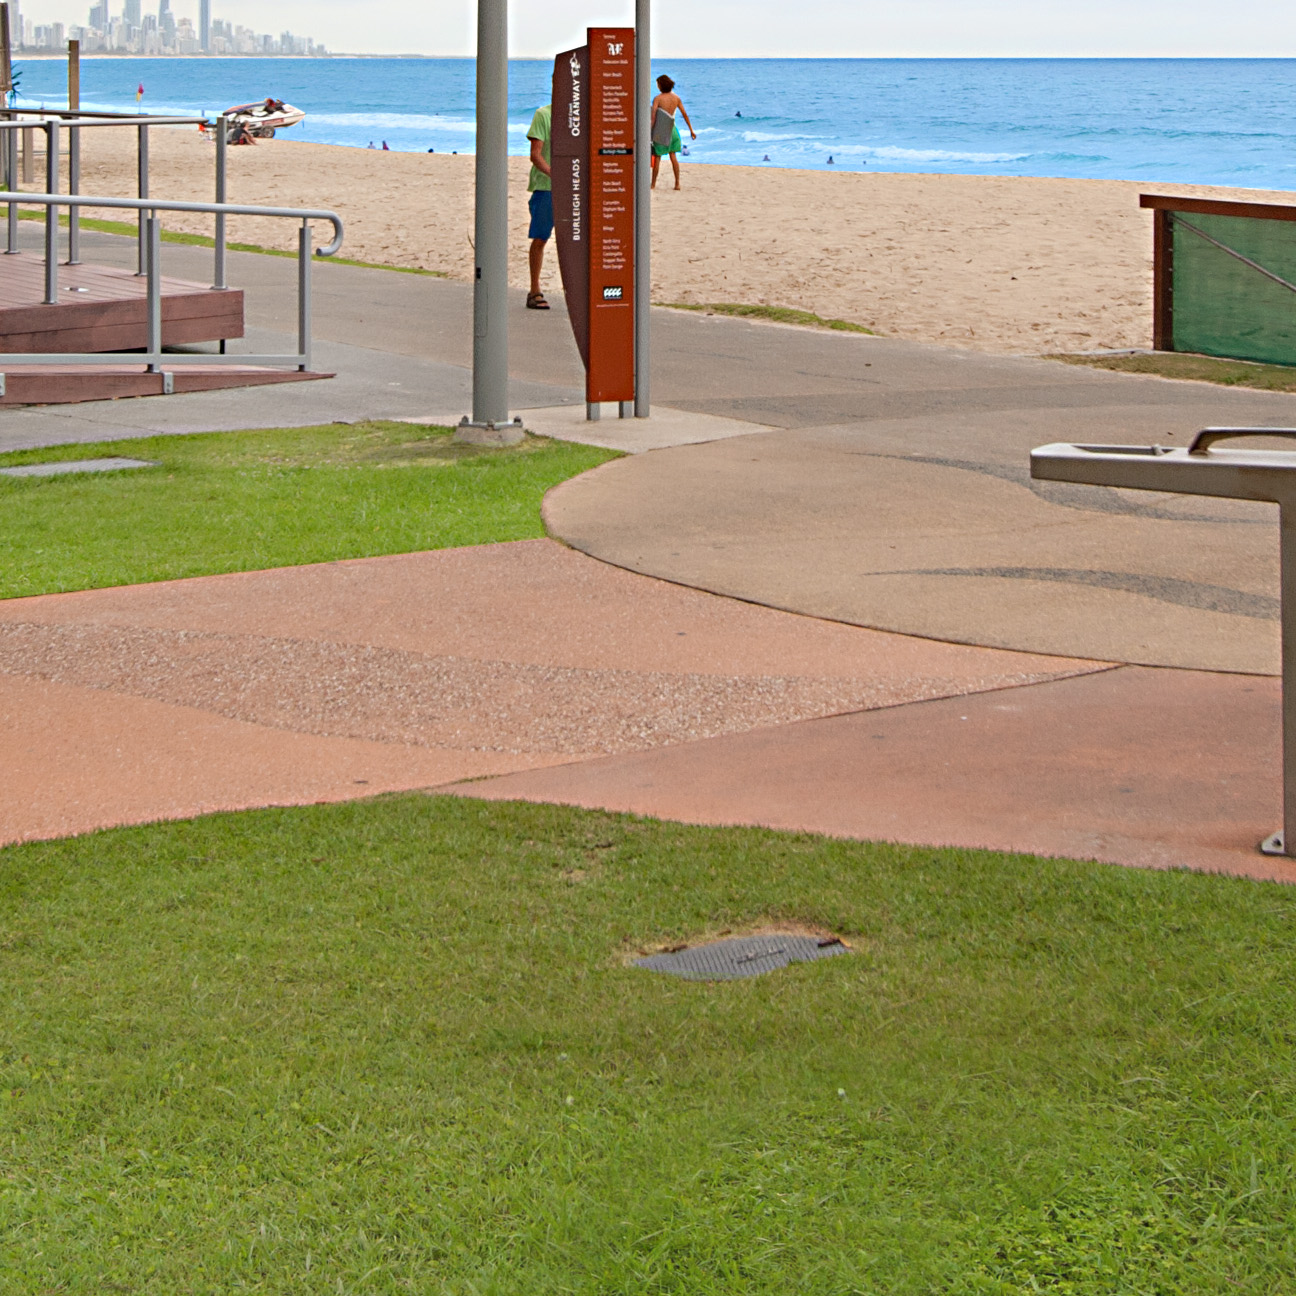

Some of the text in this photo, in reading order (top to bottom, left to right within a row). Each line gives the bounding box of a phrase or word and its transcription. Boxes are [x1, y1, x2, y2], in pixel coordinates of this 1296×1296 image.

[571, 79, 581, 137] OCEANWAY
[572, 158, 581, 241] BURLEIGH HEADS
